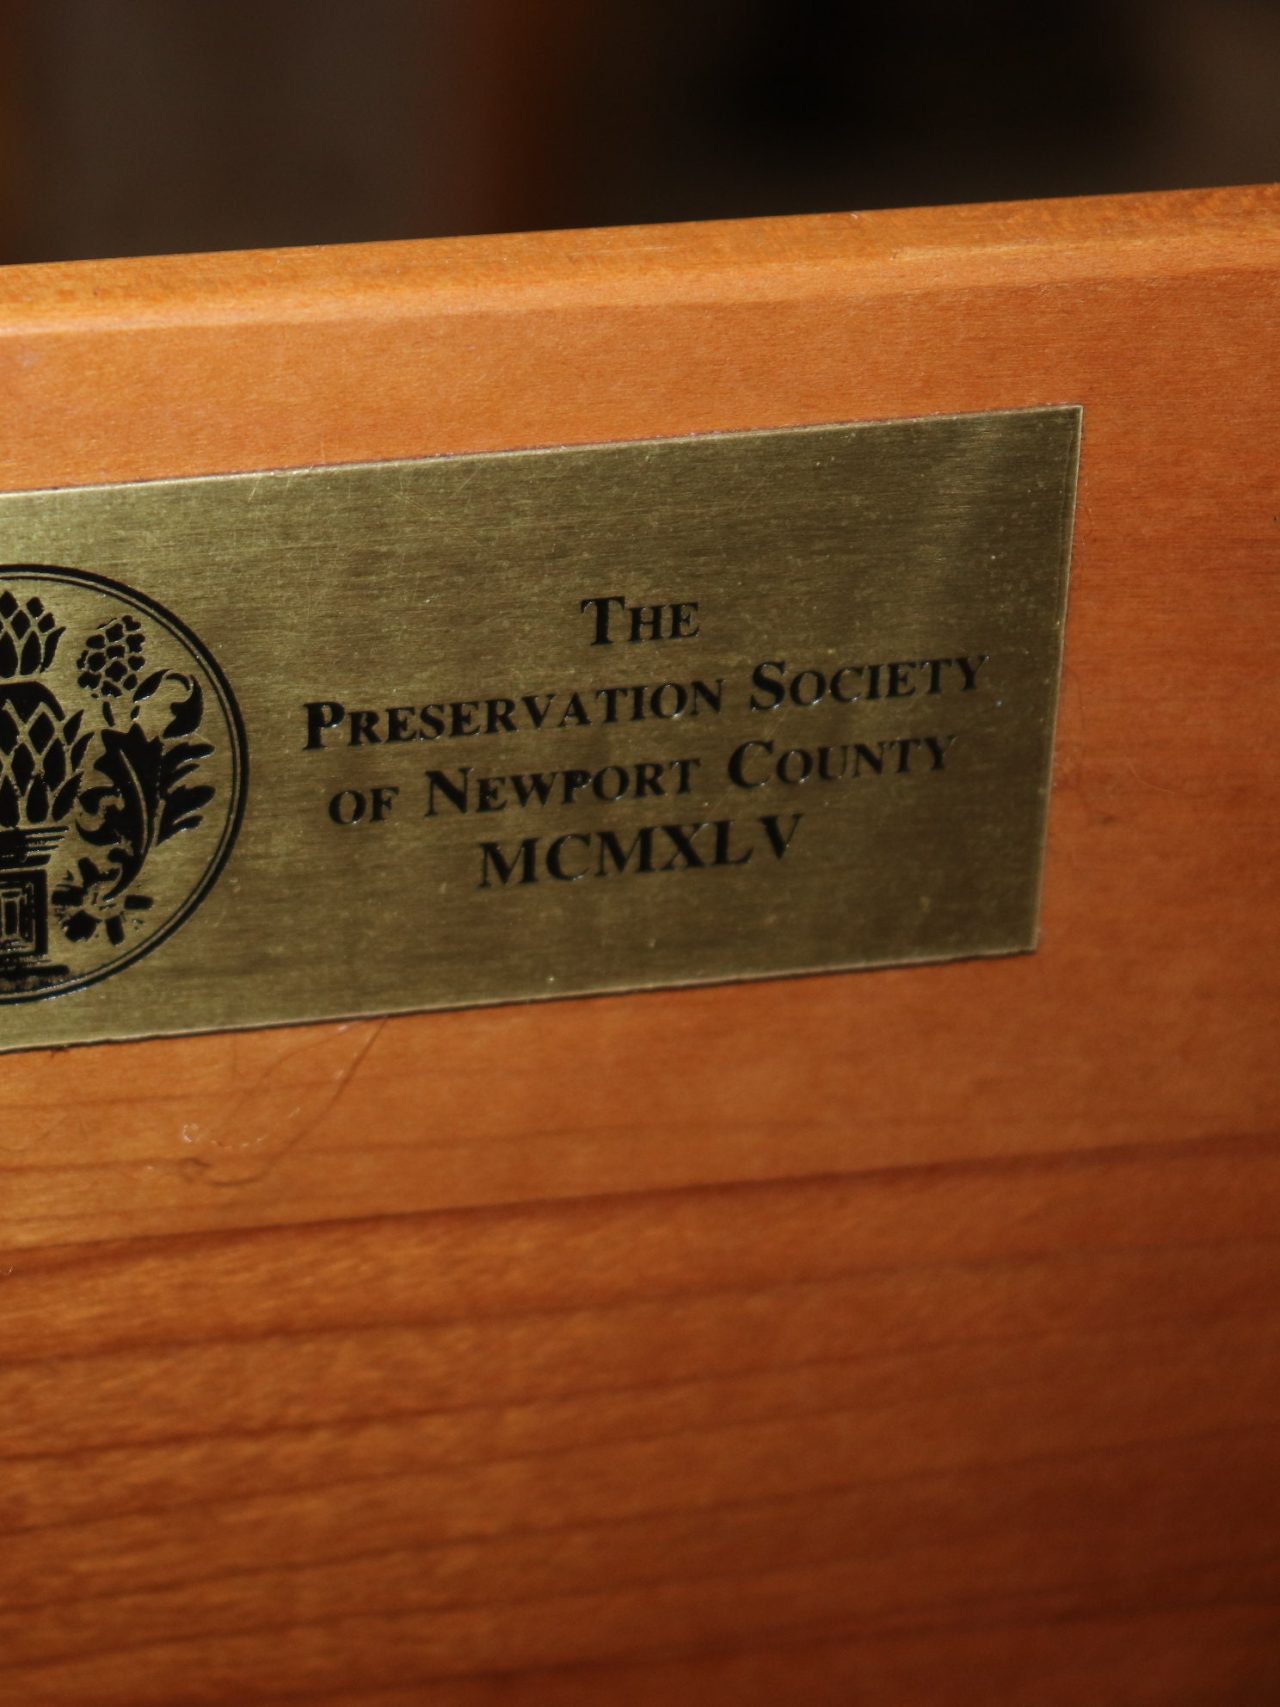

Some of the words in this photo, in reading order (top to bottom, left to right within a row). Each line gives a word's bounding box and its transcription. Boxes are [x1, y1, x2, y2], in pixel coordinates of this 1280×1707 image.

[579, 596, 700, 646] THE
[302, 677, 725, 750] PRESERVATION
[748, 655, 989, 712] SOCIETY
[327, 786, 399, 825] OF
[424, 758, 701, 817] NEWPORT
[726, 735, 957, 789] COUNTY
[477, 813, 804, 888] MCMXLV
